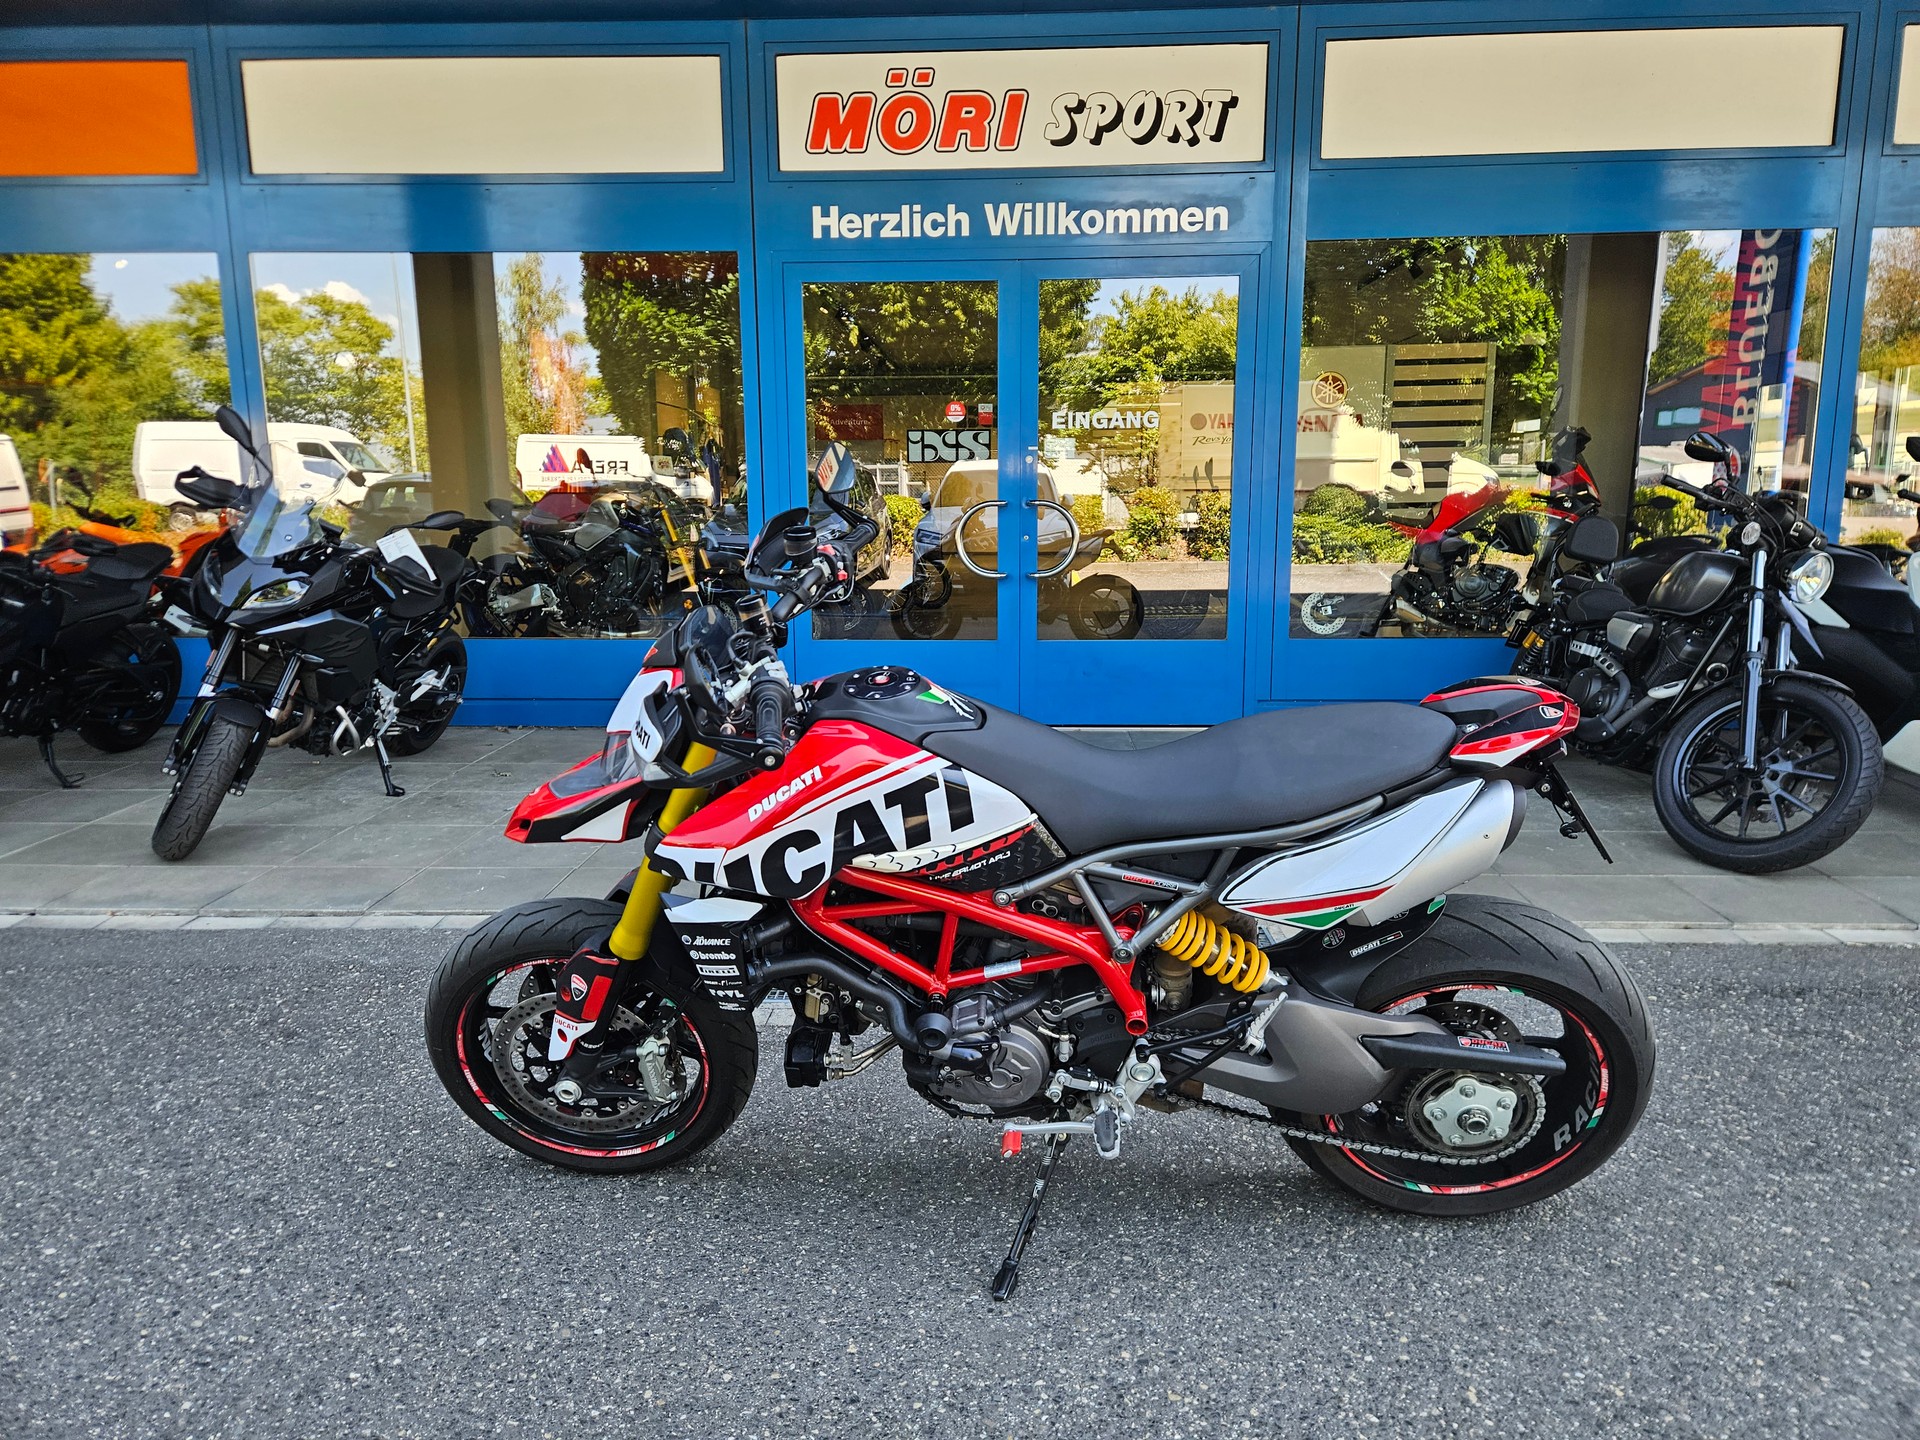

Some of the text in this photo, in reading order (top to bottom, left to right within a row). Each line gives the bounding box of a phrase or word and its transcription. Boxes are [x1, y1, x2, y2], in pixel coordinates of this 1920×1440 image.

[805, 67, 1240, 155] MÖRI SPORT
[812, 202, 1229, 239] Herzlich Willkommen
[950, 404, 962, 412] 0%
[1052, 411, 1160, 430] EINGANG
[748, 765, 823, 823] DUCATI
[693, 938, 731, 946] ADVANCE
[1351, 940, 1380, 957] DUCATI
[699, 951, 736, 960] brembo
[554, 1017, 579, 1032] DUCATI
[616, 1147, 642, 1156] DUCATI
